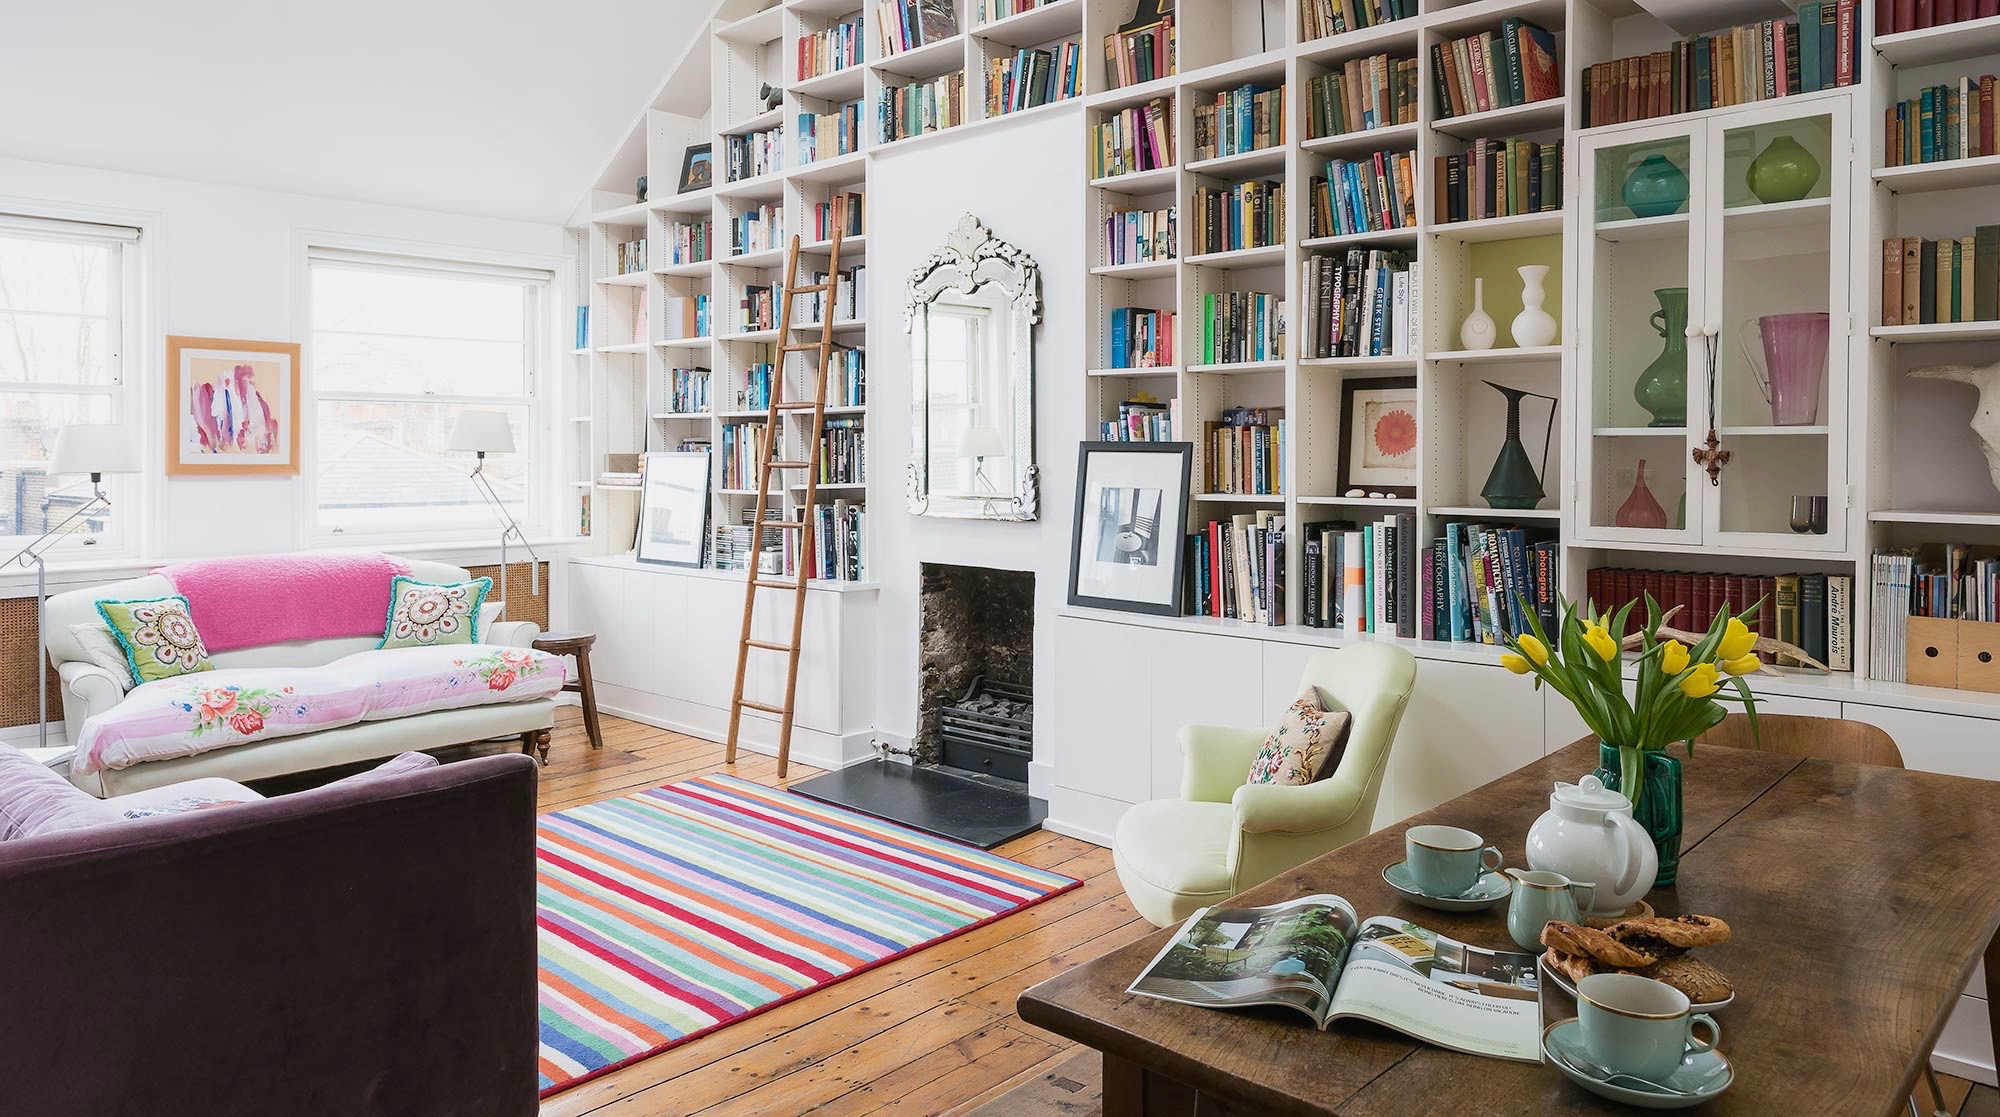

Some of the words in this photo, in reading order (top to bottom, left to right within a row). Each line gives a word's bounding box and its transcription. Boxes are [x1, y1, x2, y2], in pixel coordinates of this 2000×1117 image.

[1506, 24, 1514, 39] ALAN
[1472, 38, 1483, 67] GEORGE
[1507, 38, 1516, 55] CLARK
[1476, 67, 1484, 76] IV
[1511, 56, 1519, 90] DIARIES
[1320, 266, 1332, 301] HORST
[1332, 266, 1342, 321] TYPOGRAPHY
[1397, 289, 1405, 305] Style
[1375, 287, 1384, 314] GREEK
[1332, 323, 1338, 332] 25
[1373, 317, 1381, 342] STYLE
[1449, 552, 1457, 578] Seaside
[1487, 533, 1504, 593] ROMANTICISM
[1501, 536, 1509, 559] STUDIOS
[1505, 559, 1510, 567] BY
[1513, 546, 1522, 573] ROYAL
[1400, 556, 1408, 592] CONTACT
[1435, 542, 1444, 611] PHOTOGRAPHY
[1538, 550, 1548, 604] photograph
[1400, 593, 1408, 624] SHEETS
[1831, 585, 1841, 614] André
[1831, 616, 1840, 654] Maurois
